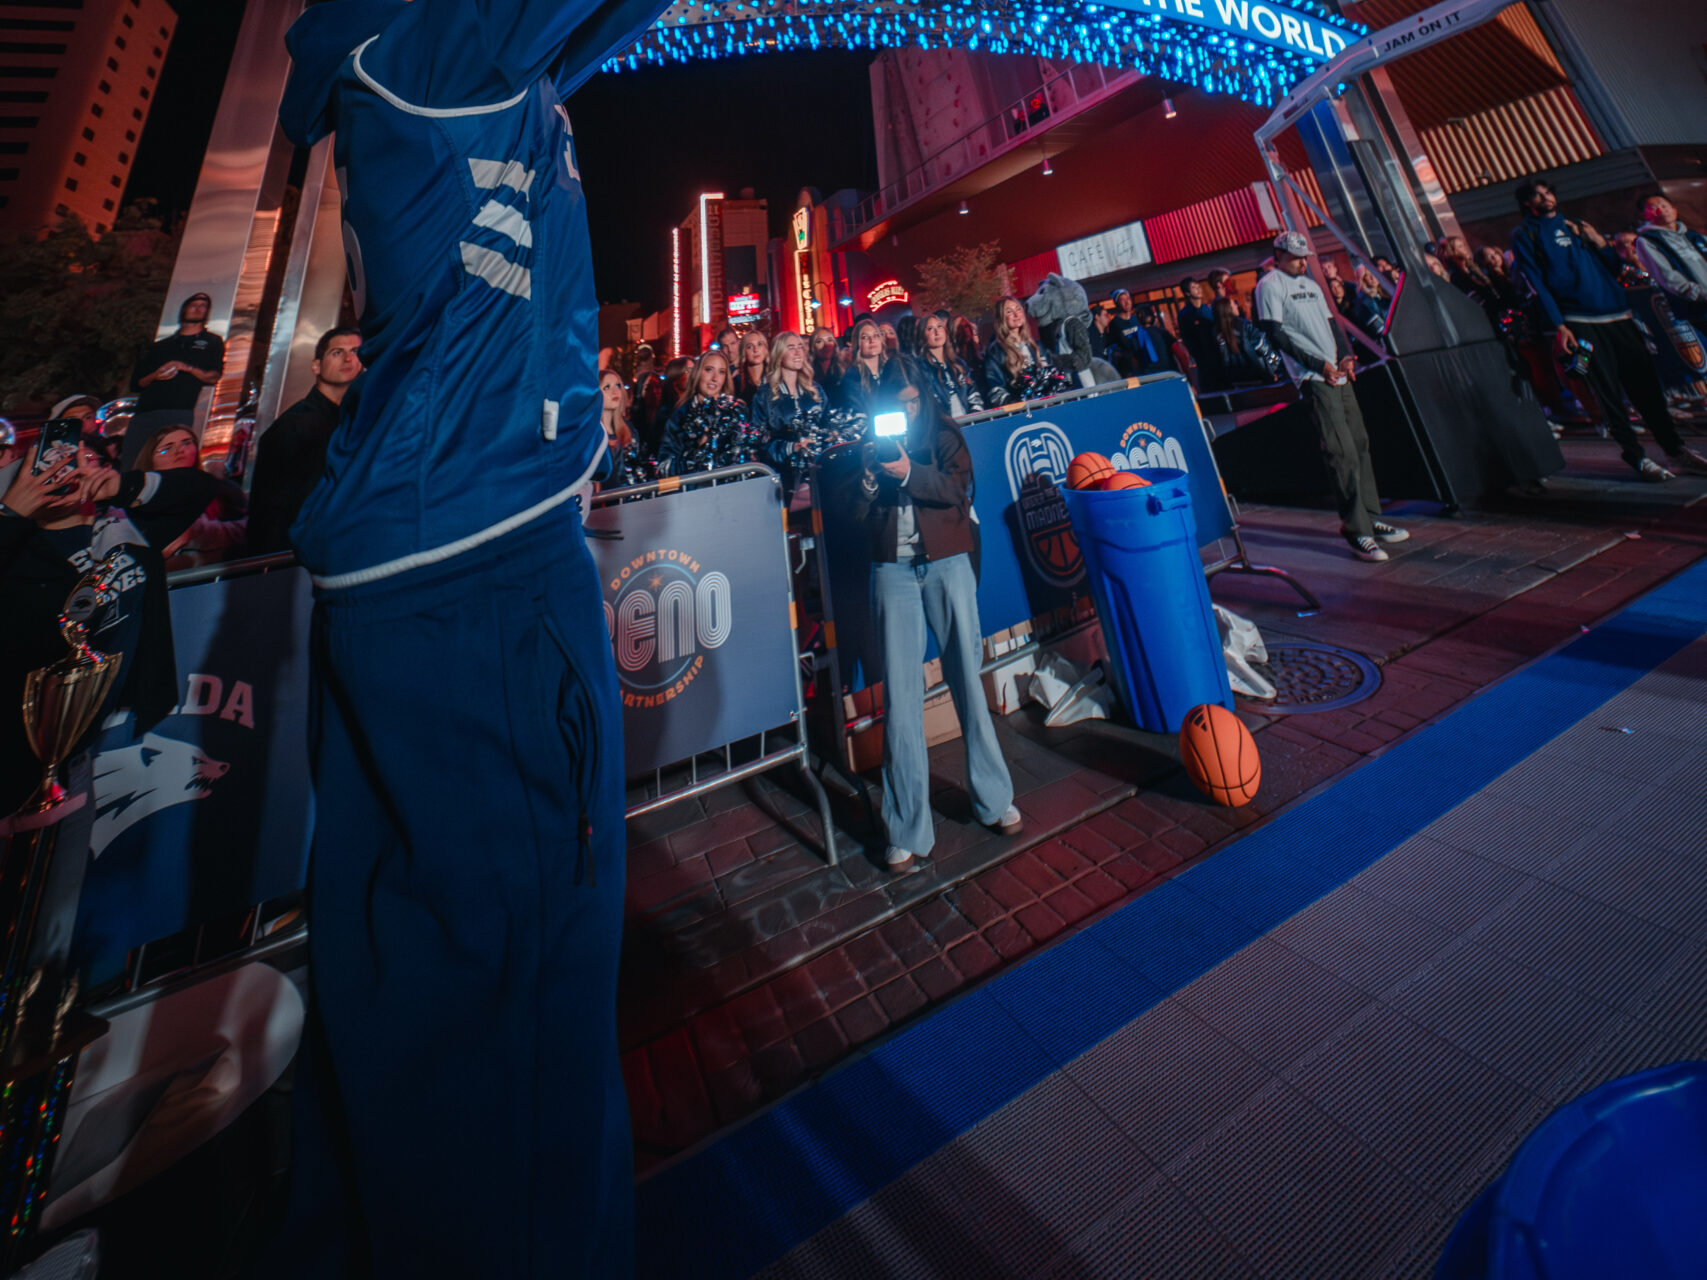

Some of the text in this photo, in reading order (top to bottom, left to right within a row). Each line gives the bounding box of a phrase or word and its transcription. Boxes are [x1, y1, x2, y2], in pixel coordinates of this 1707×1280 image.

[1384, 10, 1461, 52] JAM ON IT
[1120, 421, 1162, 448] DOWNTOWN
[1026, 501, 1070, 531] MADNE
[610, 548, 701, 592] DOWNTOWN
[603, 571, 732, 672] ENO
[620, 655, 704, 708] RTNERSHIP
